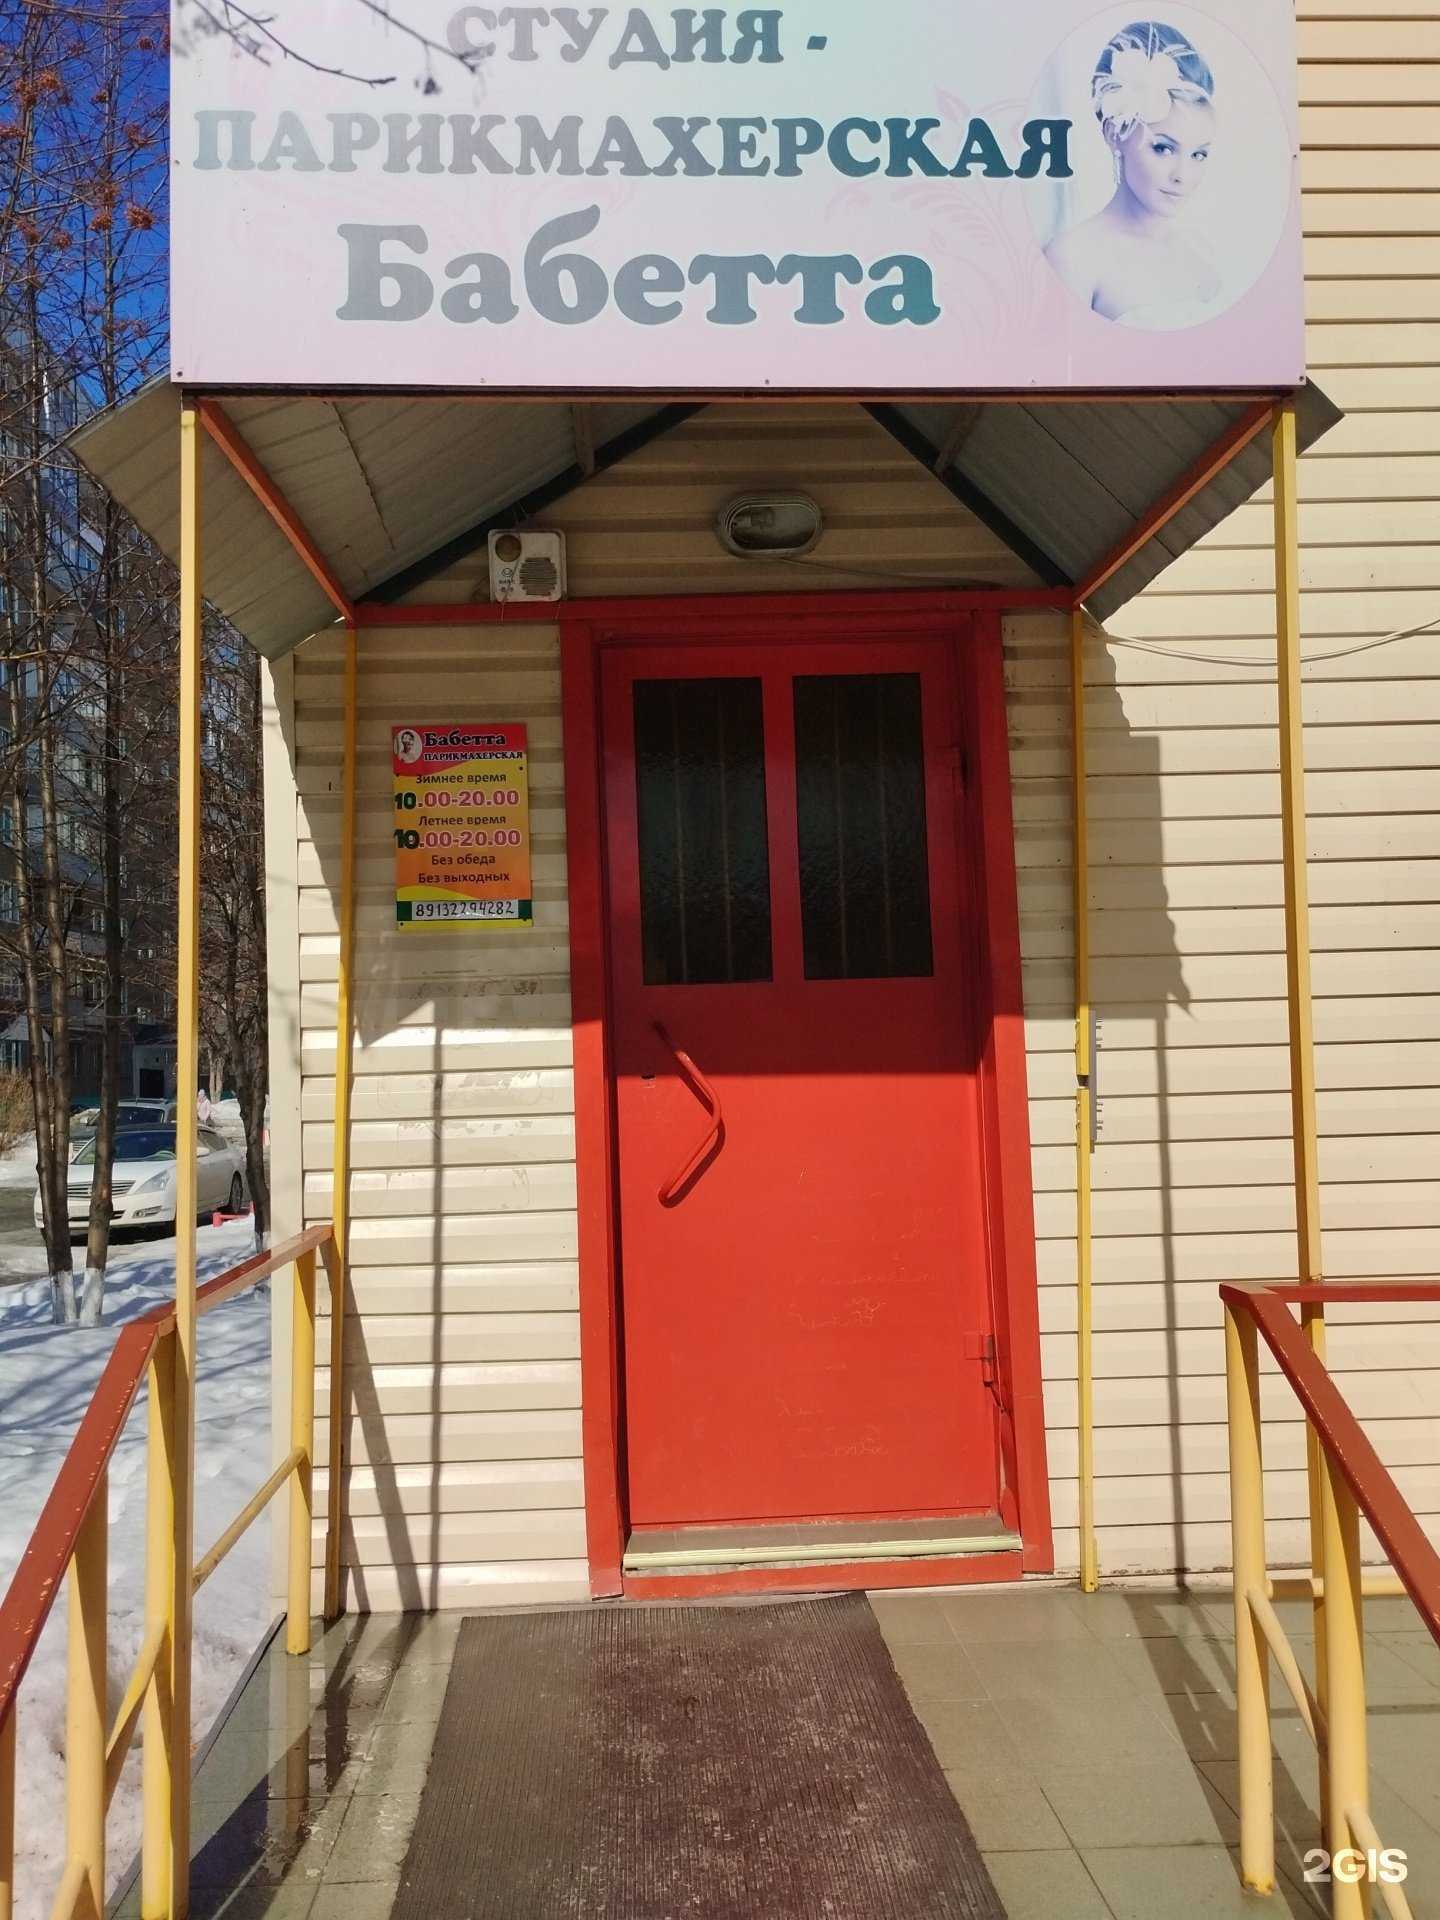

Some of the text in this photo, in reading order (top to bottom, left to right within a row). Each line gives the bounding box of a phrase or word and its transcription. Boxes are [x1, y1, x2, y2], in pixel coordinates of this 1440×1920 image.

[446, 7, 784, 70] СТУДИЯ
[193, 110, 1073, 178] ПАРИКМАХЕРСКАЯ
[335, 204, 941, 325] Бабетта
[424, 731, 506, 746] Бабетта
[424, 751, 523, 761] ПАРИКМАХЕРСКАЯ
[416, 774, 507, 785] Зимнее время
[395, 790, 519, 809] 10.00-20.00
[418, 816, 507, 826] Летнее время
[431, 854, 496, 866] Без обеда
[418, 872, 510, 884] Без выходных
